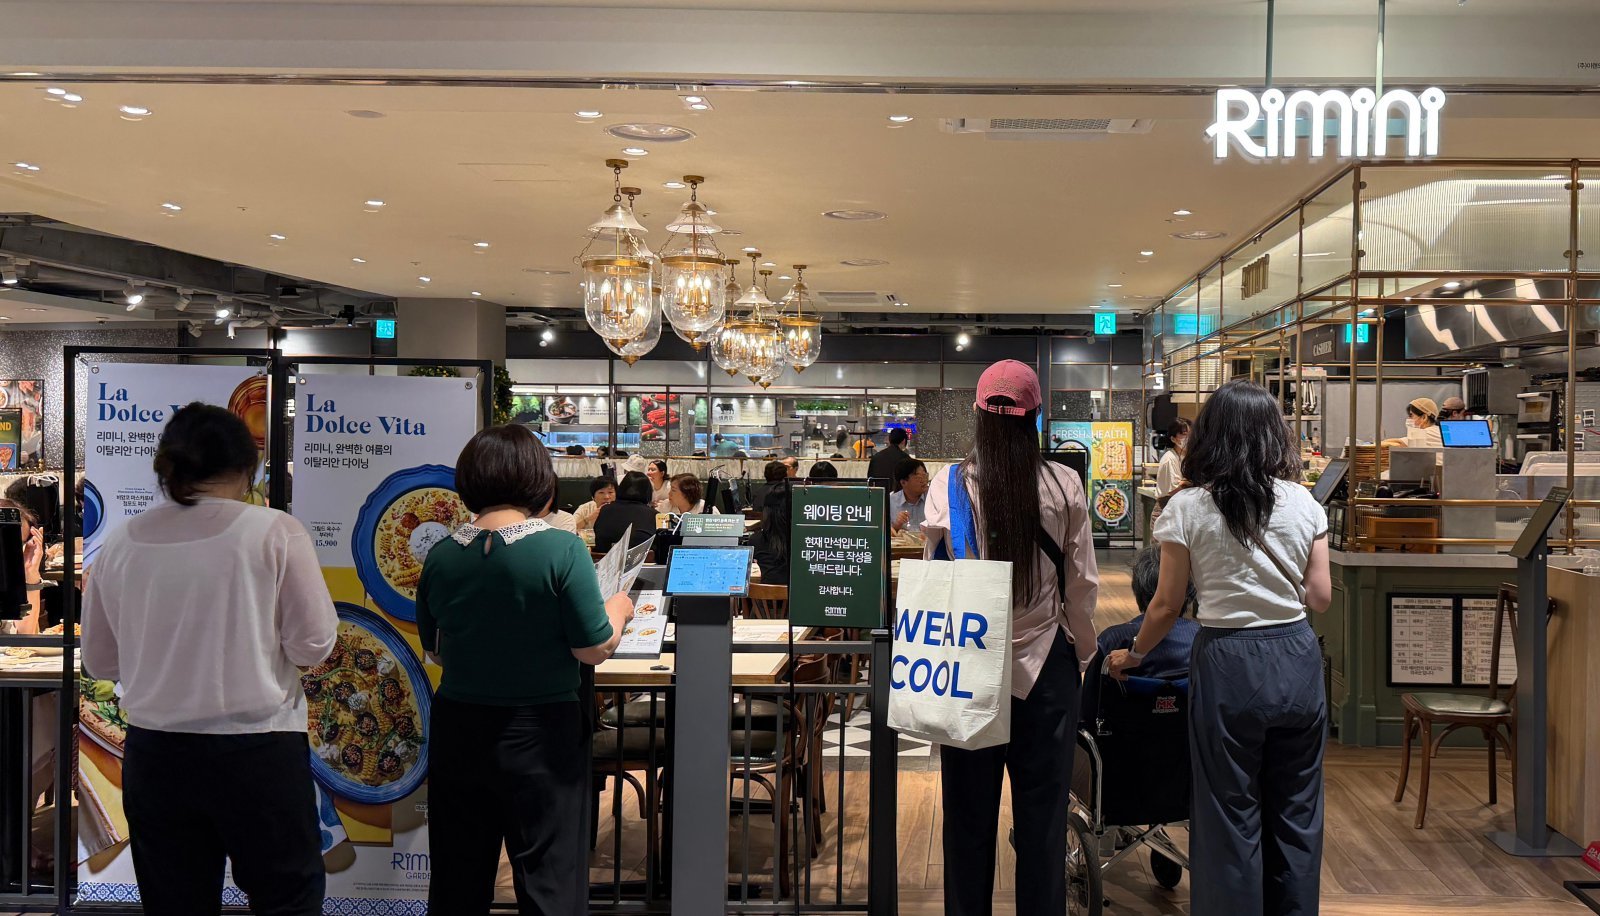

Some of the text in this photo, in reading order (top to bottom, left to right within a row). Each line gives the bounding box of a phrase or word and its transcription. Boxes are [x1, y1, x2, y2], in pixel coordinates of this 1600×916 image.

[98, 382, 129, 401] La
[305, 393, 336, 413] La
[97, 403, 164, 423] Dolce
[305, 414, 426, 435] Dolce Vita
[96, 431, 126, 444] 리미니,
[127, 431, 155, 443] 완벽한
[1055, 430, 1086, 439] FRESH
[1091, 430, 1128, 439] HEALTH
[96, 445, 132, 457] 이탈리안
[304, 442, 392, 455] 리미니, 완벽한 여름의
[304, 457, 369, 469] 이탈리안 다이닝
[803, 504, 872, 522] 웨이팅 안내
[315, 539, 338, 547] 15,900
[804, 536, 870, 549] 현재 만석입니다.
[801, 550, 873, 563] 대기리스트 작성을
[808, 563, 863, 576] 부탁드립니다.
[818, 585, 854, 596] 감사합니다.
[894, 608, 988, 650] WEAR
[890, 654, 973, 699] COOL
